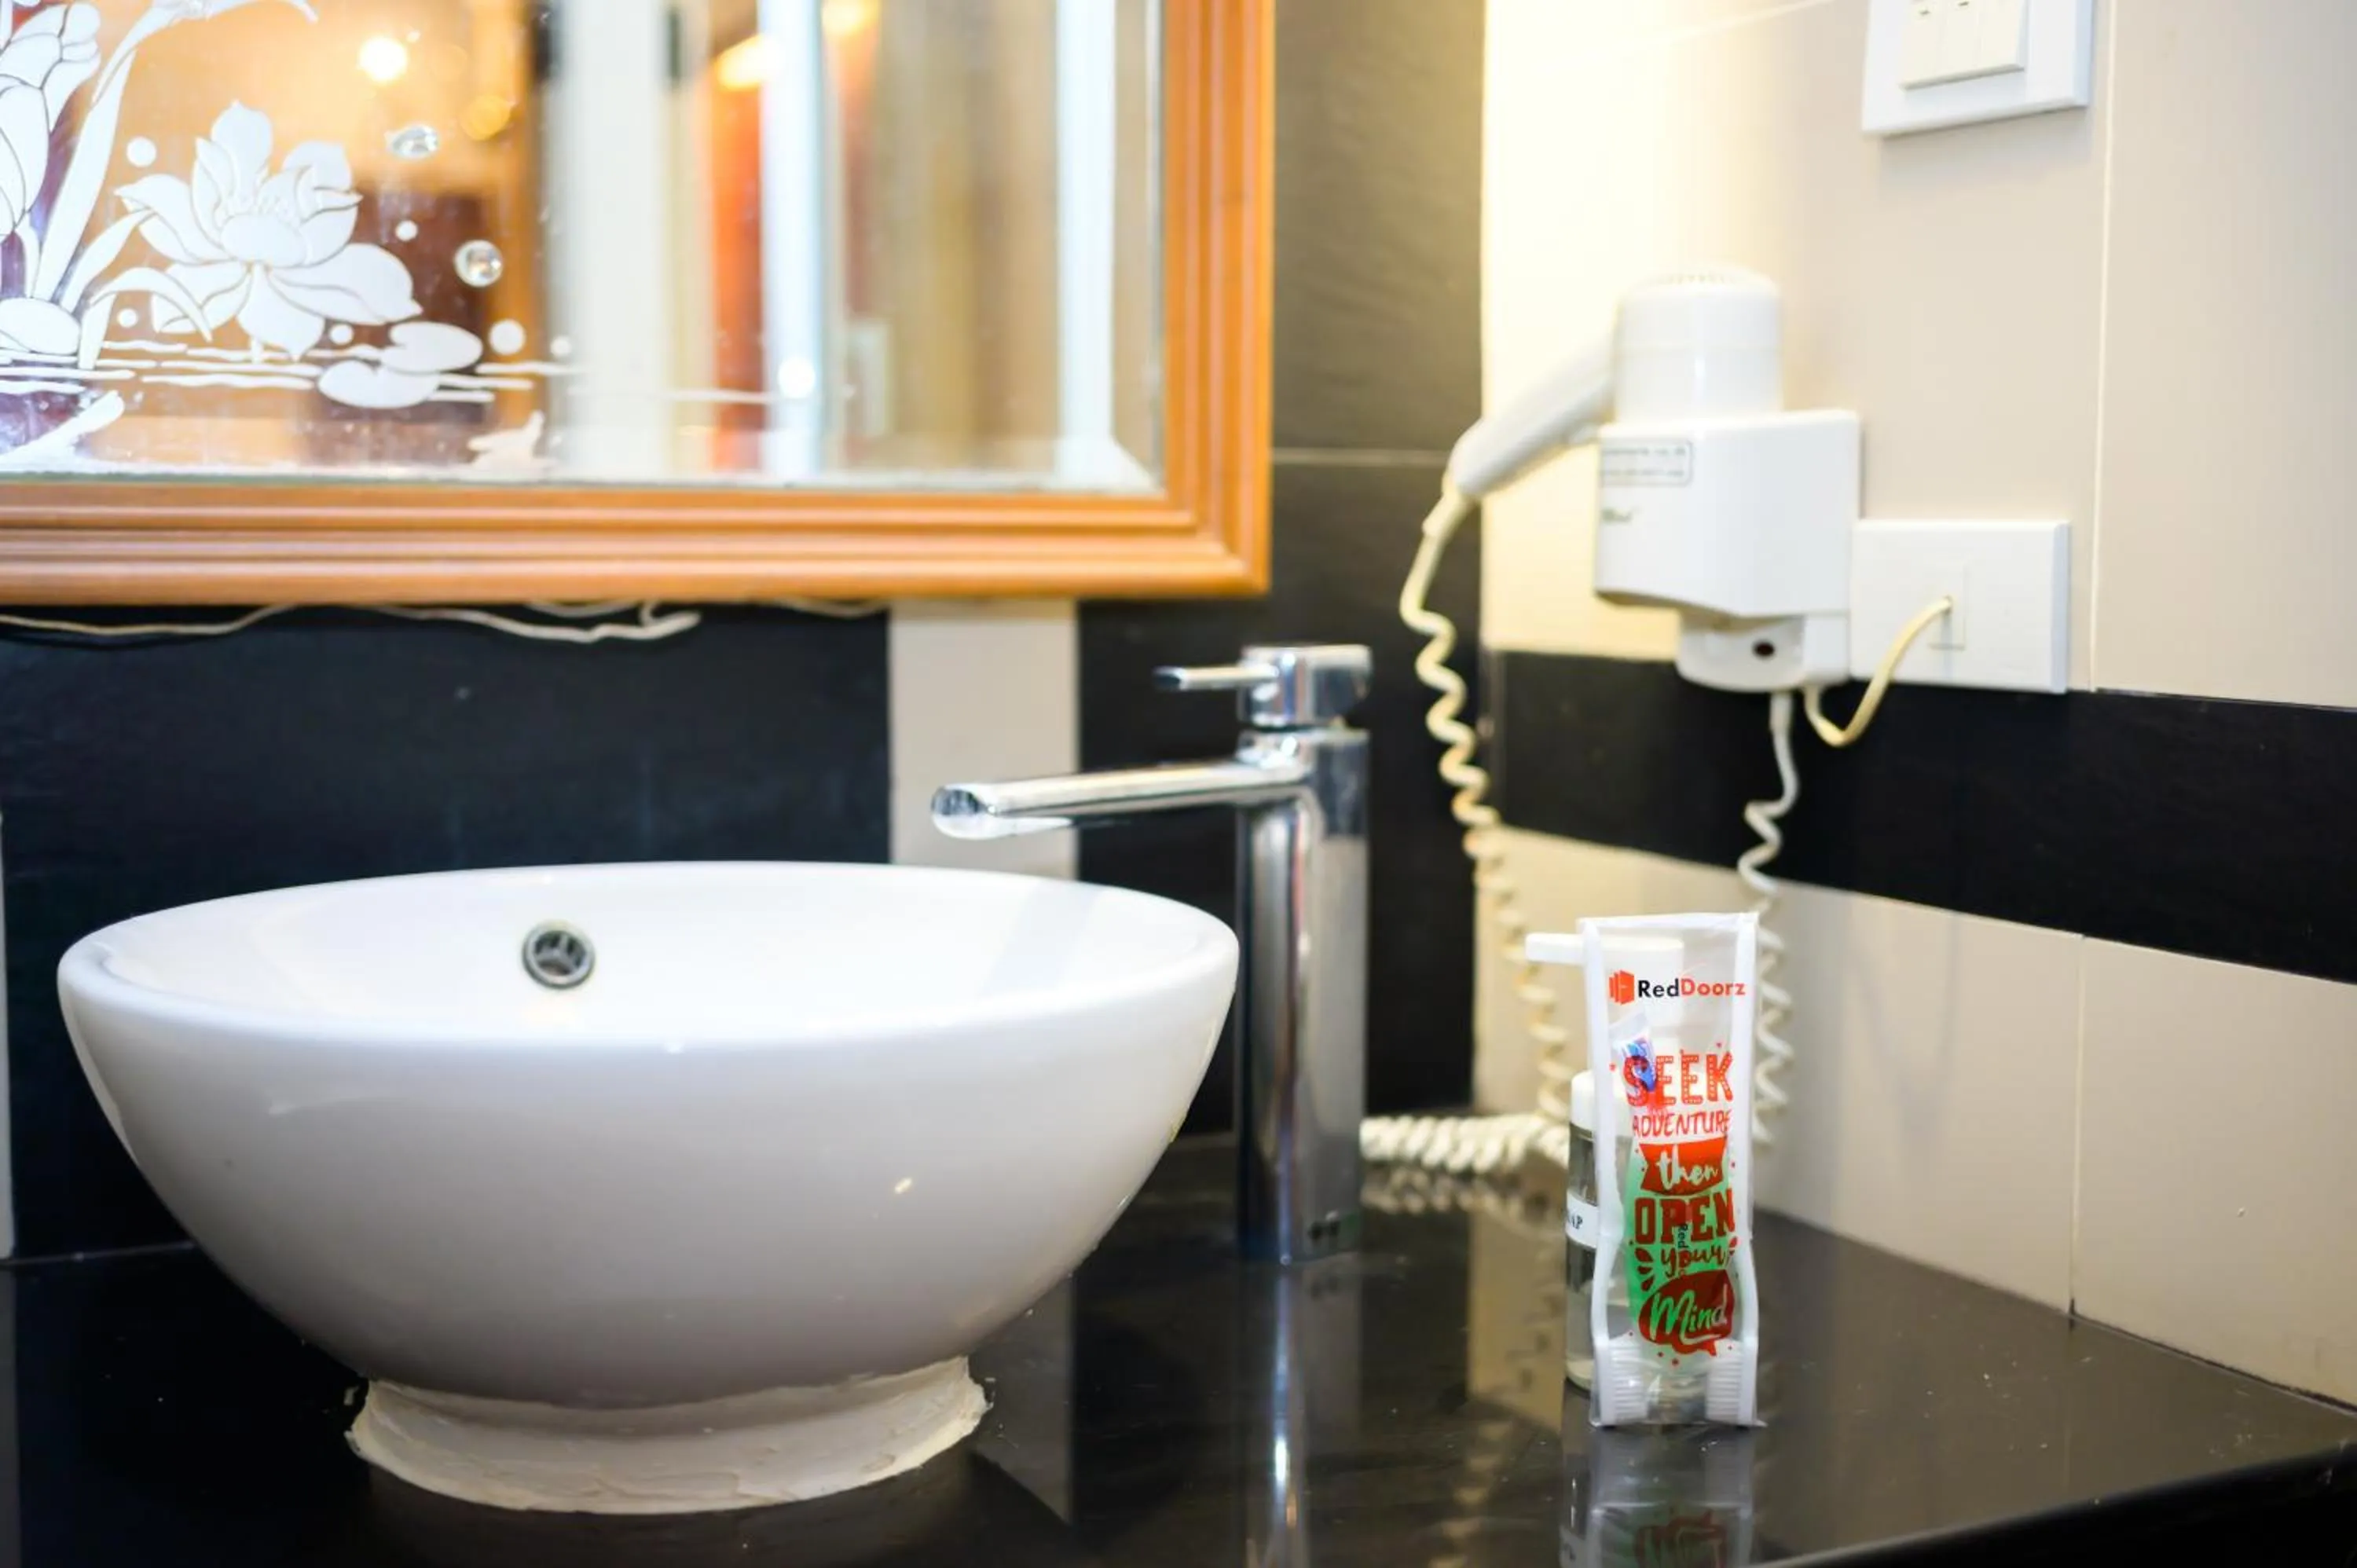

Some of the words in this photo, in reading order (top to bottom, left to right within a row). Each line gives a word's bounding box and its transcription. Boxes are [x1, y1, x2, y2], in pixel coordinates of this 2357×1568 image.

[1637, 977, 1746, 998] RedDoorz
[1623, 1051, 1734, 1107] SEEK
[1655, 1145, 1718, 1189] then
[1634, 1188, 1736, 1244] OPEN
[1660, 1244, 1728, 1278] your
[1648, 1283, 1729, 1344] Mind
